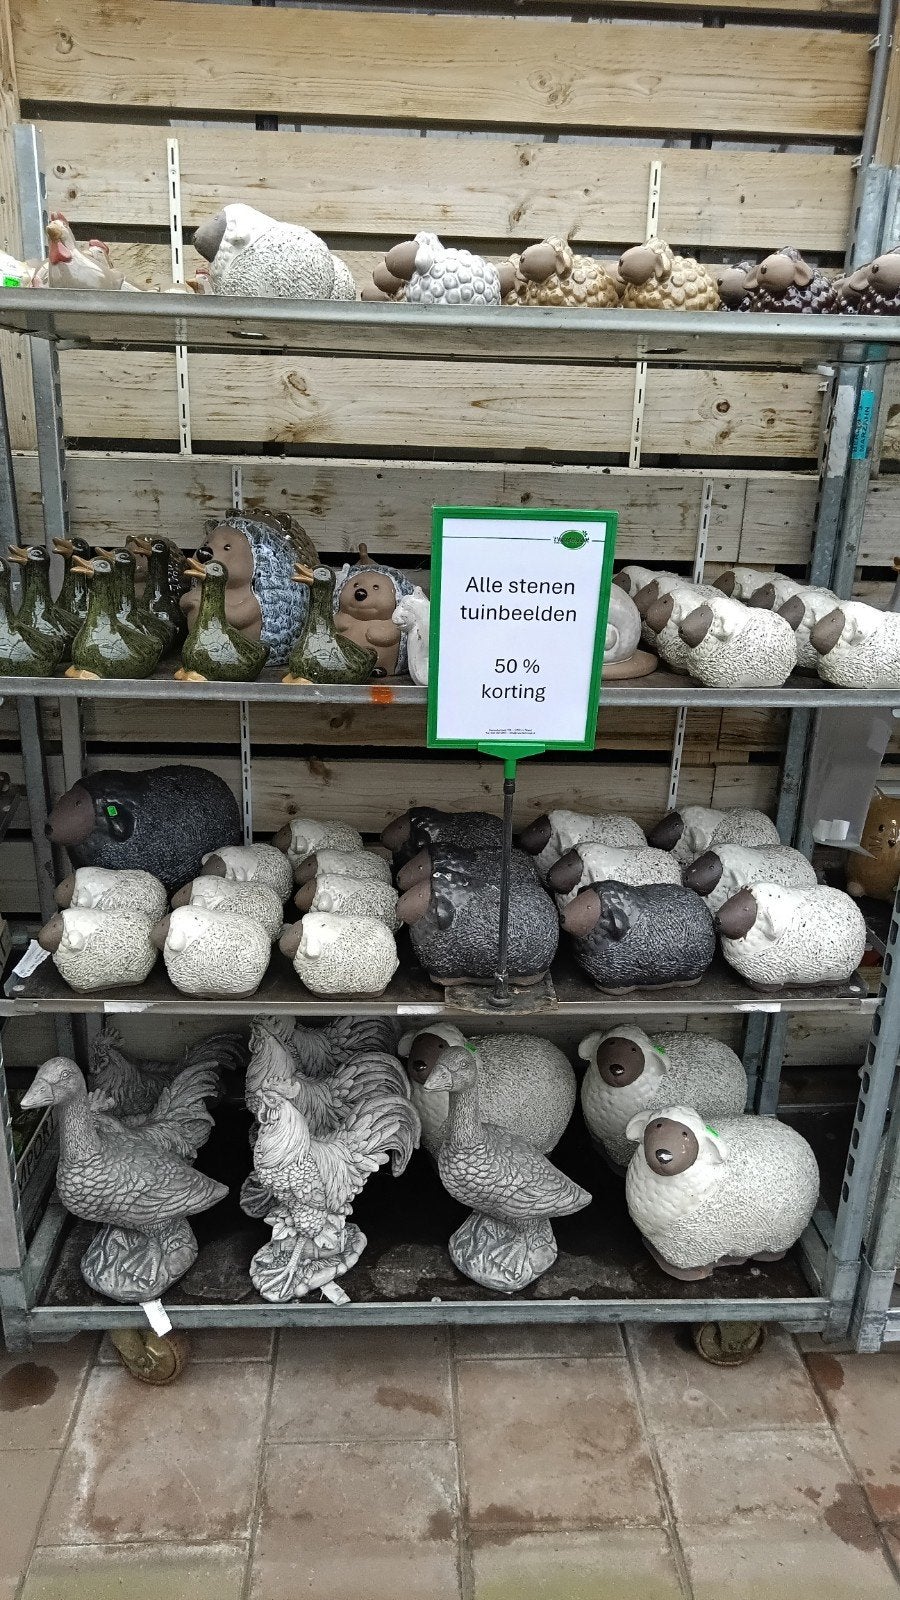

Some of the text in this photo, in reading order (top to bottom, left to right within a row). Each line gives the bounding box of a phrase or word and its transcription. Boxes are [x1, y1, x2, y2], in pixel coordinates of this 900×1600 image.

[465, 576, 575, 595] Alle stenen
[460, 604, 577, 622] tuinbeelden
[494, 658, 540, 674] 50 %
[481, 683, 547, 703] korting
